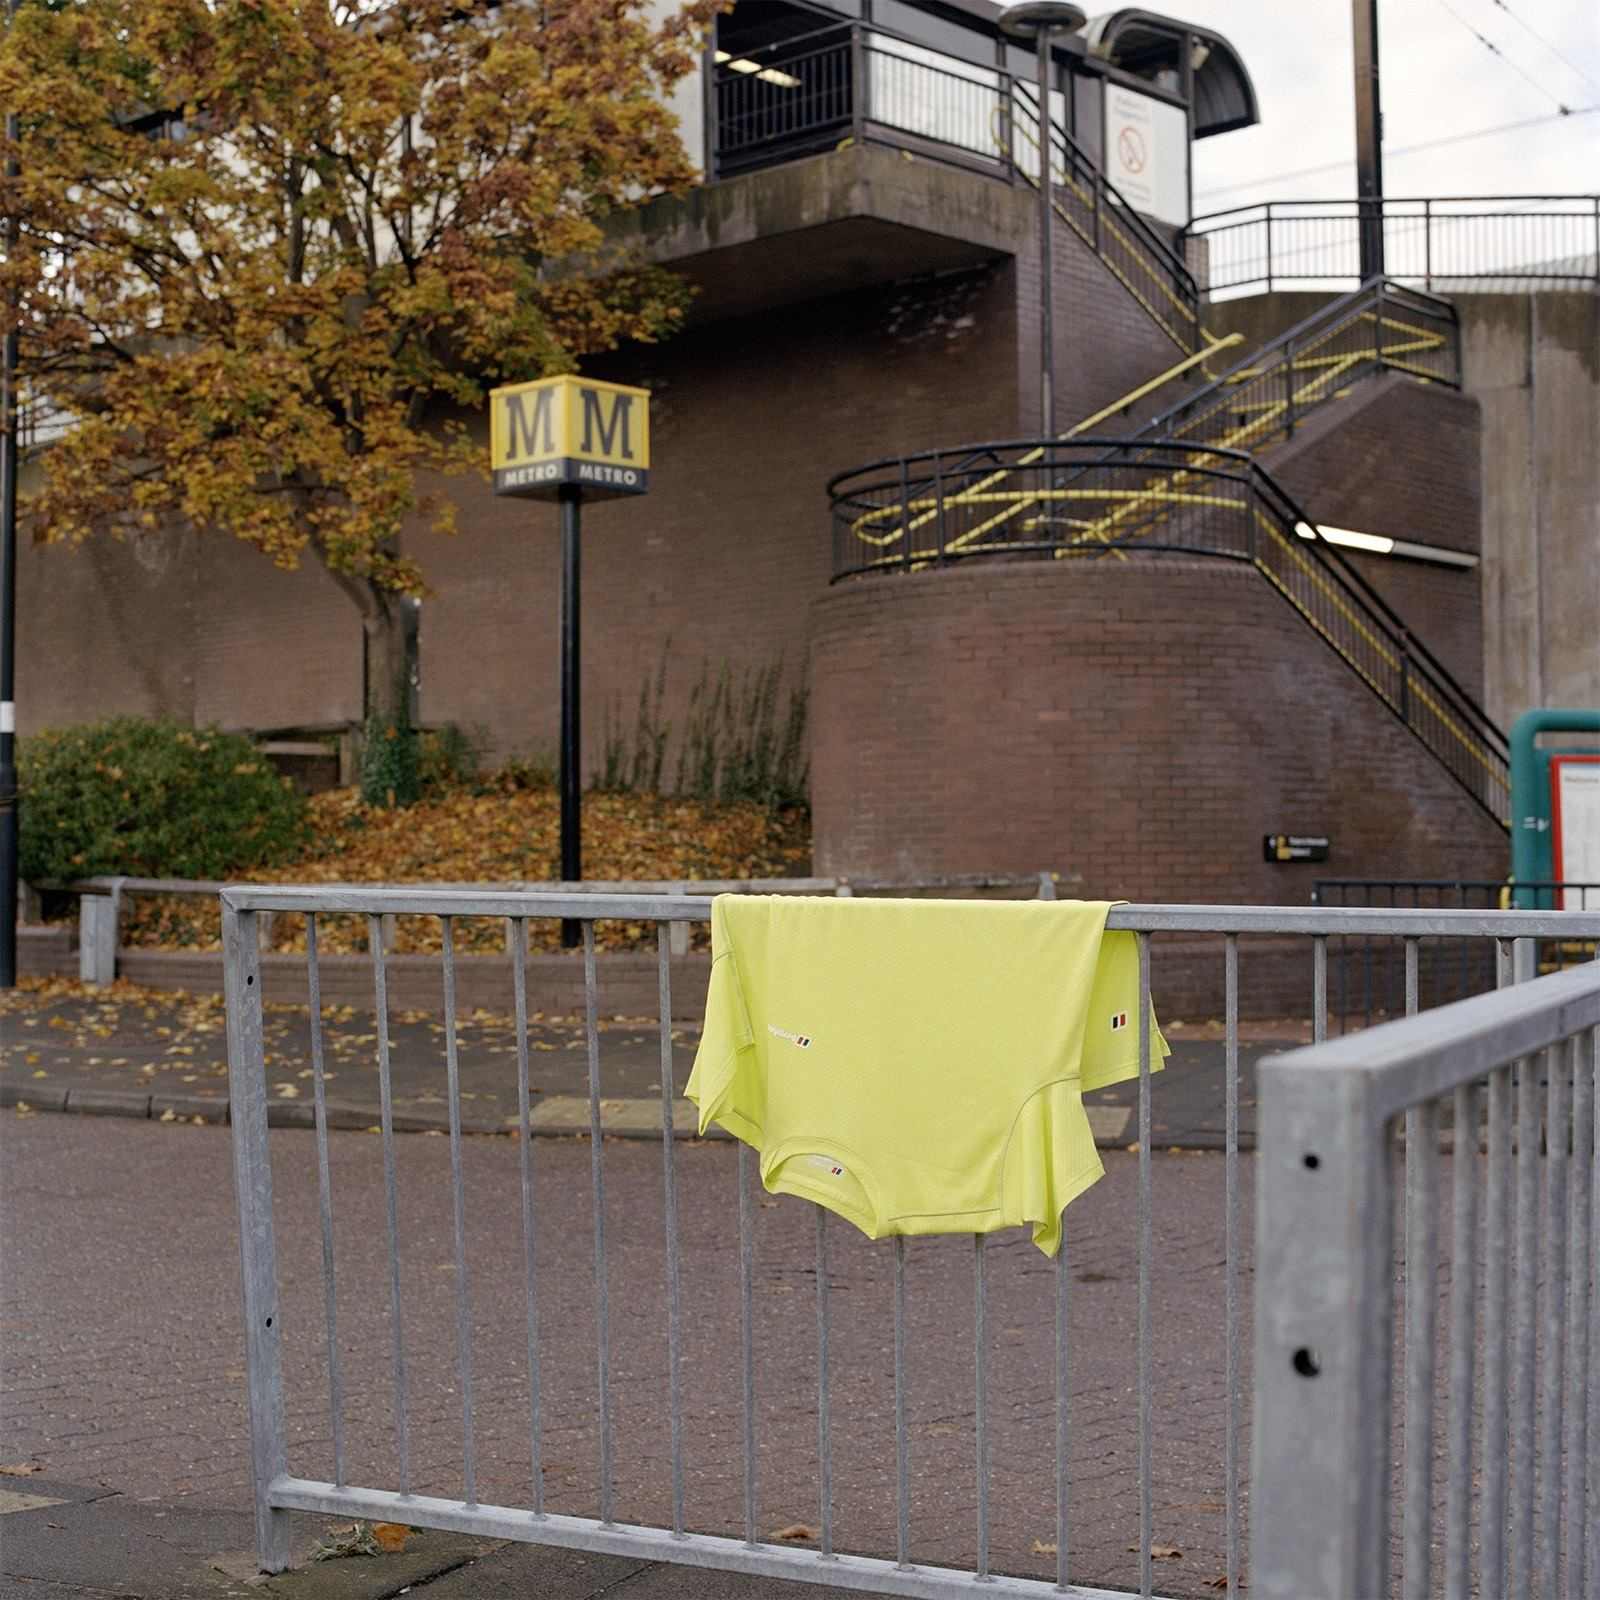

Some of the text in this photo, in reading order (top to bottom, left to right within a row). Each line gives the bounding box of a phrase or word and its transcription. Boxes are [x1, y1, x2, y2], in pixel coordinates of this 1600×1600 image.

[506, 388, 554, 459] M
[580, 388, 633, 459] M
[504, 464, 557, 486] METRO
[579, 465, 637, 485] METRO
